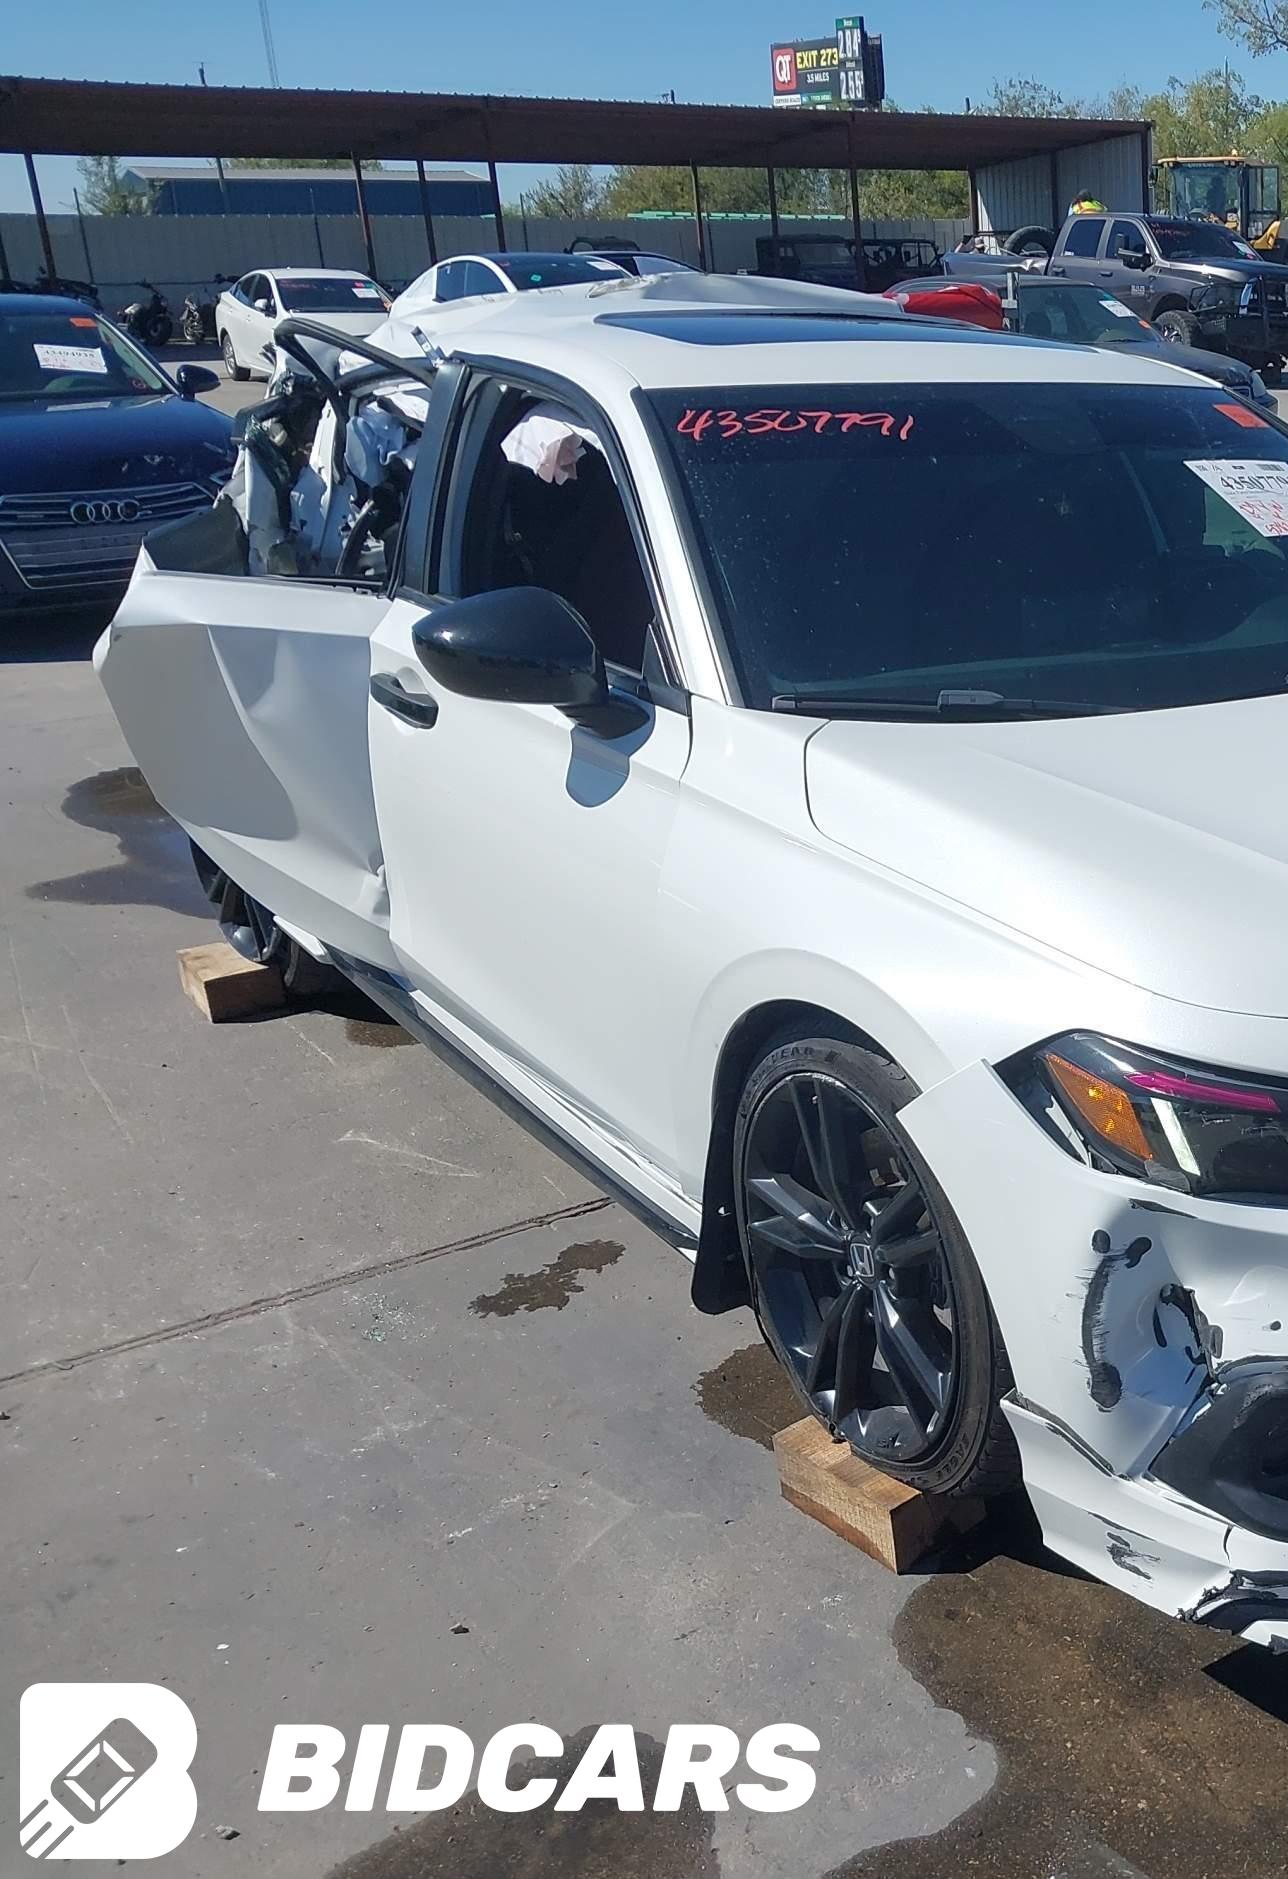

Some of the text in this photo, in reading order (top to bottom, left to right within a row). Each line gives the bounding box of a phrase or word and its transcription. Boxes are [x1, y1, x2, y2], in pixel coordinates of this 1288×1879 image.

[775, 55, 791, 84] QT
[796, 48, 838, 69] EXIT 273
[814, 71, 830, 82] MILES
[677, 409, 914, 441] 43507791
